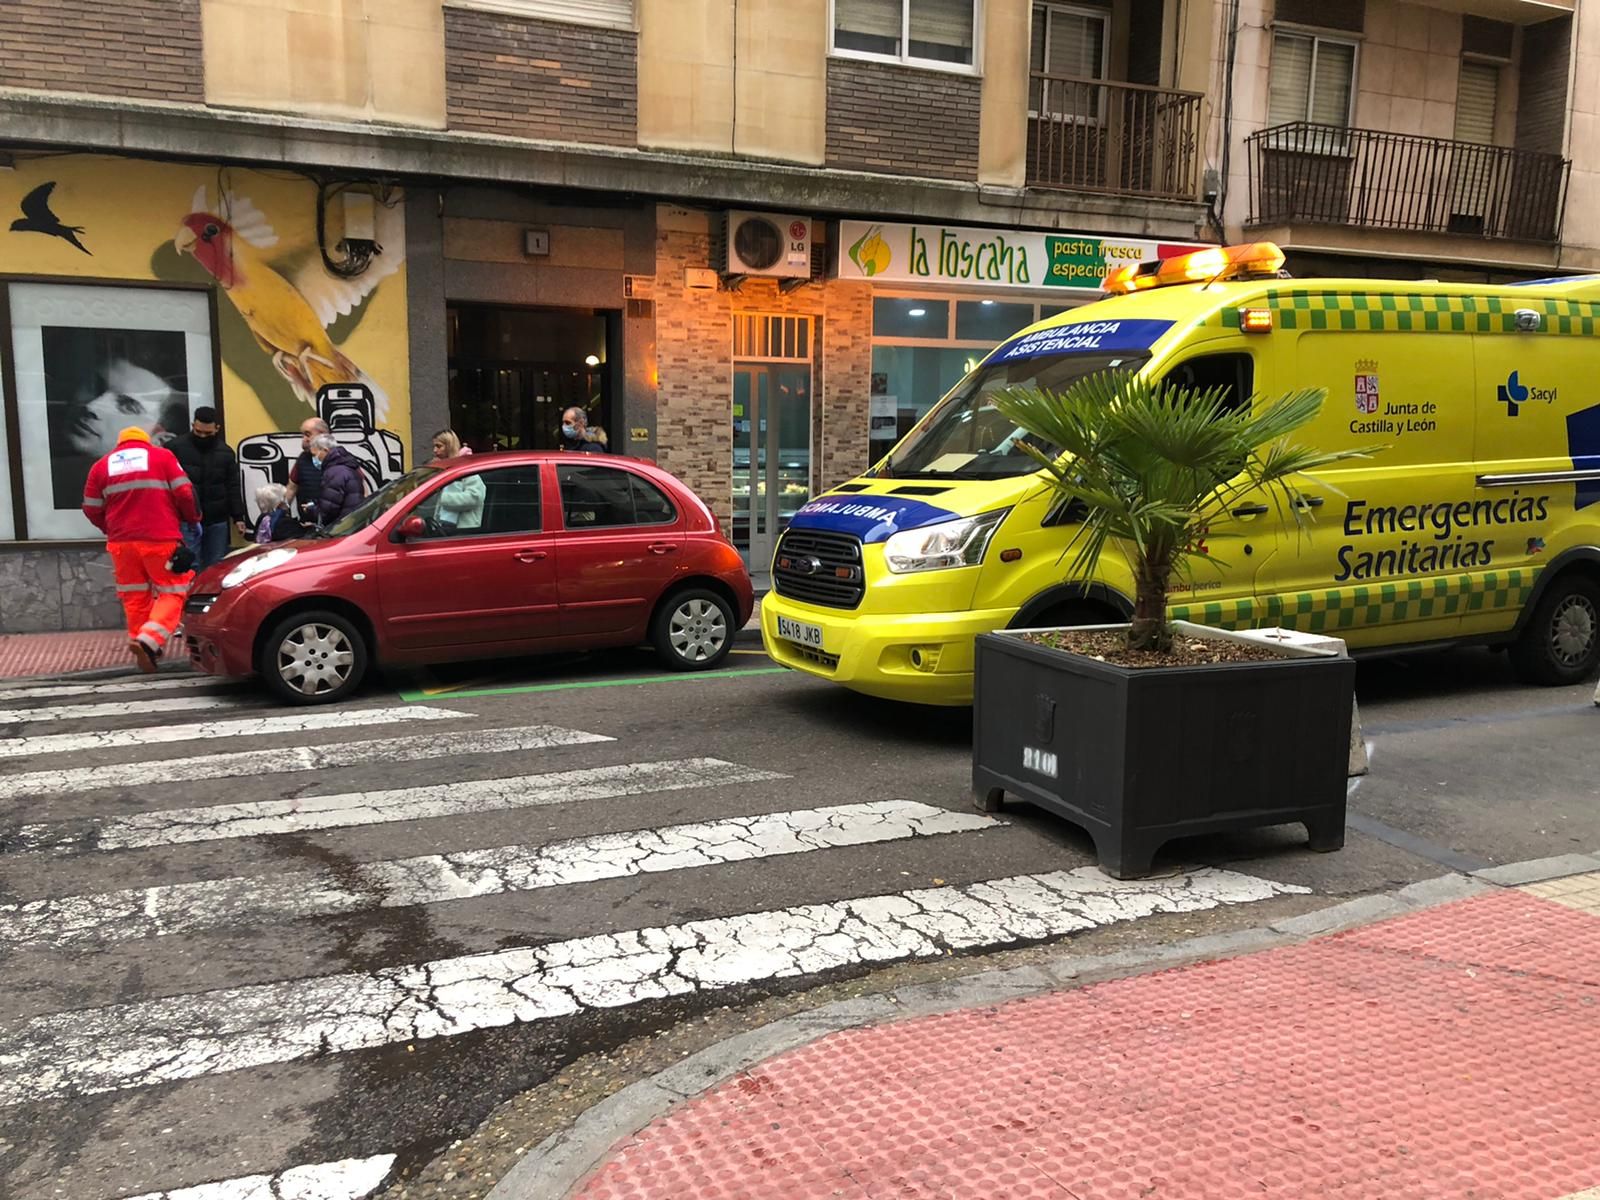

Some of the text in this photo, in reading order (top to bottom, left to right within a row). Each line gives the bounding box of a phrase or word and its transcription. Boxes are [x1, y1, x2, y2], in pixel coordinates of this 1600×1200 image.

[791, 242, 805, 252] LG
[909, 227, 1031, 284] la Toscana
[1054, 239, 1142, 259] pasta fresca
[1017, 322, 1121, 346] AMBULANCIA
[1003, 335, 1102, 359] ASISTENCIAL
[1530, 387, 1557, 404] Sacyl
[1384, 401, 1436, 415] Junta de
[1350, 418, 1436, 436] Castilla y León
[1343, 490, 1549, 540] Emergencias
[1334, 535, 1494, 581] Sanitarias
[782, 619, 820, 644] 5418 JKB
